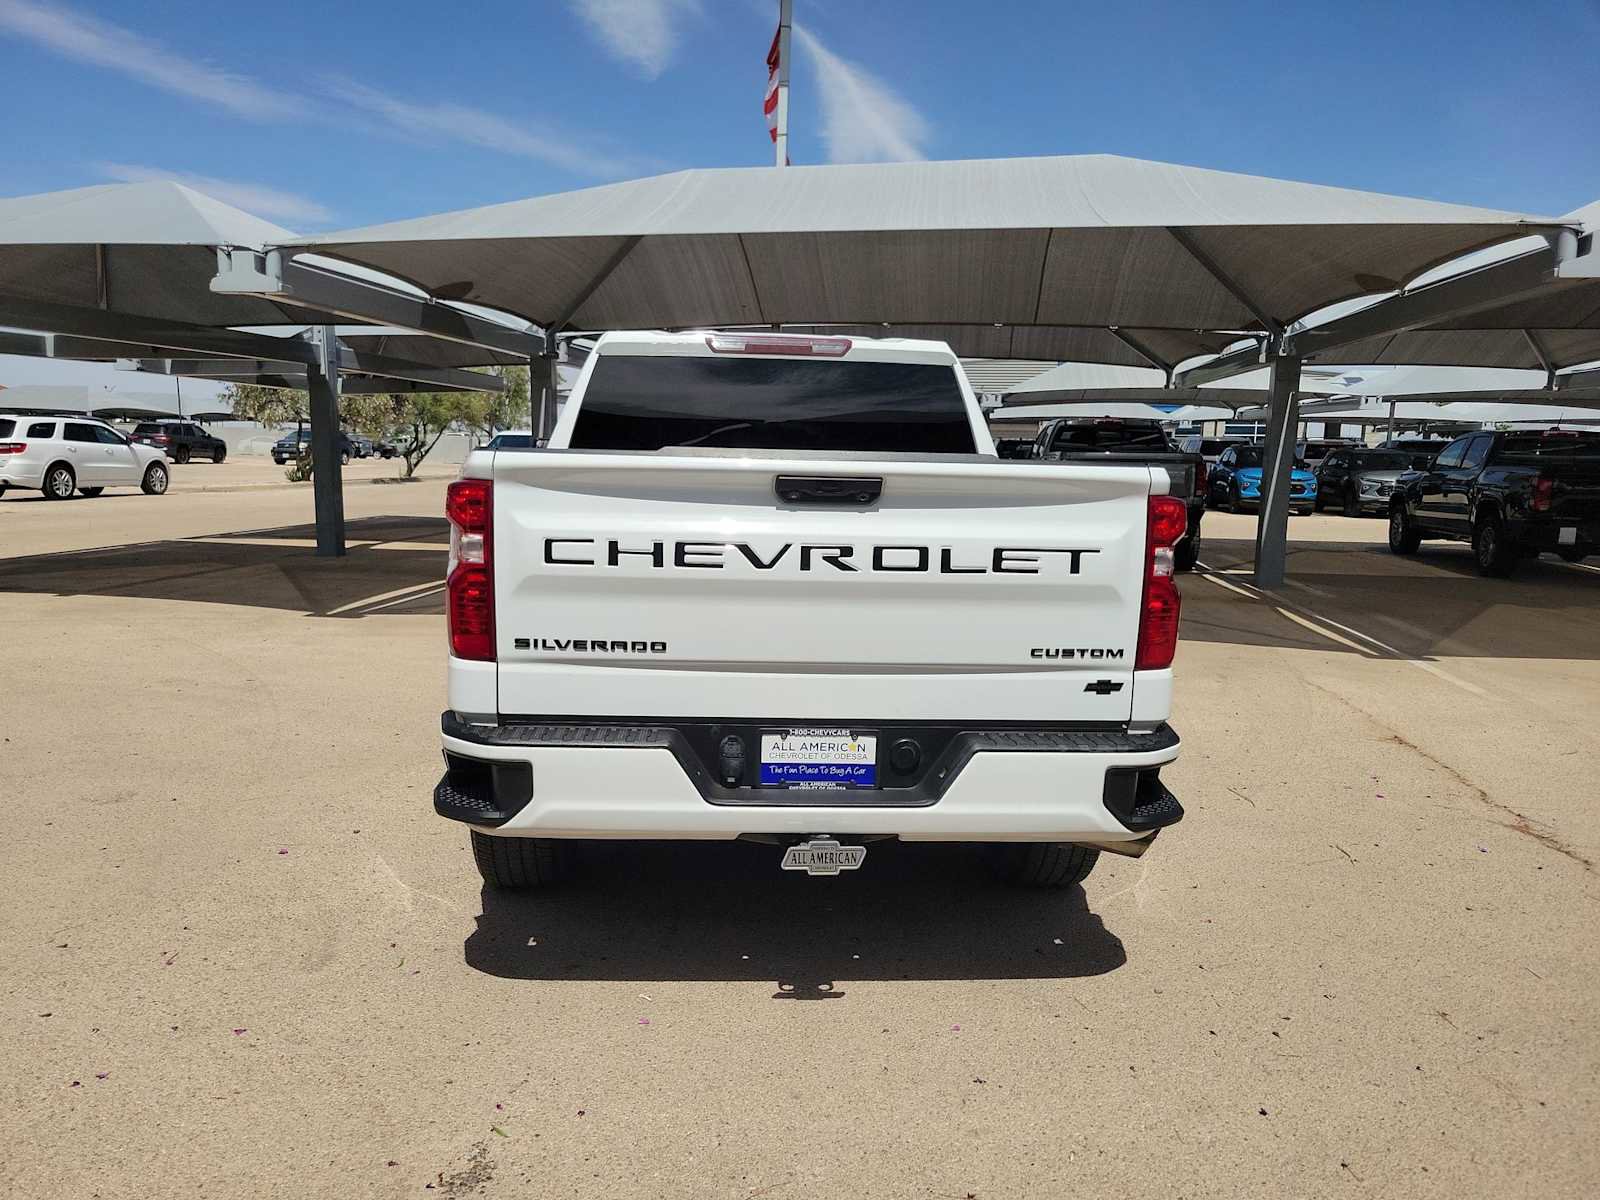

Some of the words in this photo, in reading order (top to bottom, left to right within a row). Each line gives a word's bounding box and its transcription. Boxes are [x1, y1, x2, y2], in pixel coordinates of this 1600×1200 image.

[544, 537, 1101, 575] CHEVROLET
[514, 638, 667, 653] SILVERADO
[1030, 648, 1124, 659] CUSTOM
[771, 742, 795, 751] ALL
[769, 752, 818, 760] CHEVROLET
[820, 752, 831, 760] OF
[833, 752, 868, 760] ODESSA
[820, 766, 829, 774] To
[853, 767, 866, 775] Car
[791, 852, 807, 864] ALL
[809, 852, 857, 864] AMERICAN
